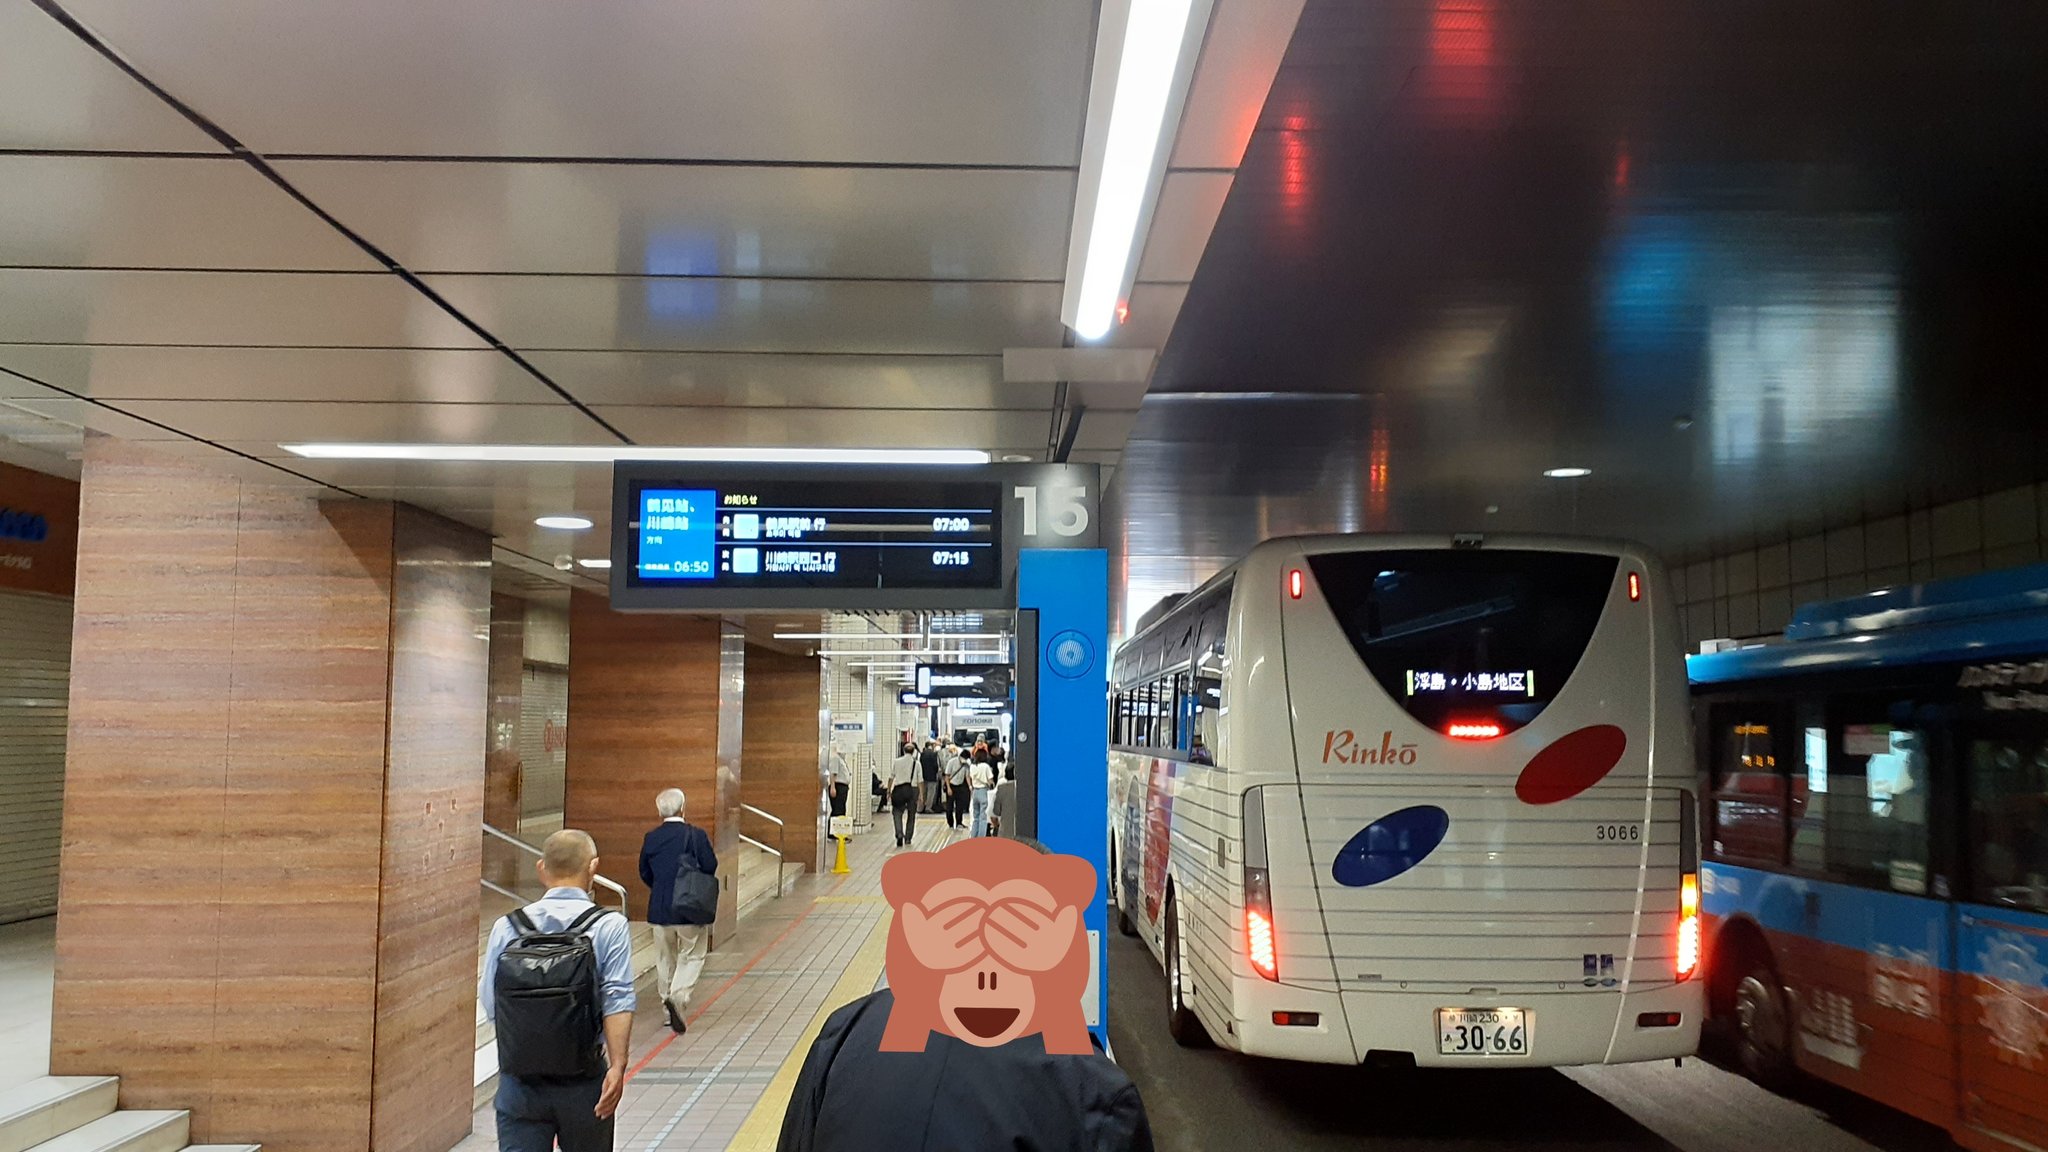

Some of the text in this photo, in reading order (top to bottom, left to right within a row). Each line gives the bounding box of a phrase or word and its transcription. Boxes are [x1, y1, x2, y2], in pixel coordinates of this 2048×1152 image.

[724, 495, 758, 505] お知らせ
[1014, 485, 1089, 537] 15
[932, 518, 970, 532] 07:00
[932, 551, 969, 565] 07:15
[674, 561, 709, 573] 06:50
[1414, 672, 1526, 691] 浮島・小島地区
[1322, 729, 1418, 765] Rinkō
[1597, 825, 1638, 840] 3066
[1455, 1025, 1522, 1051] 30-66
